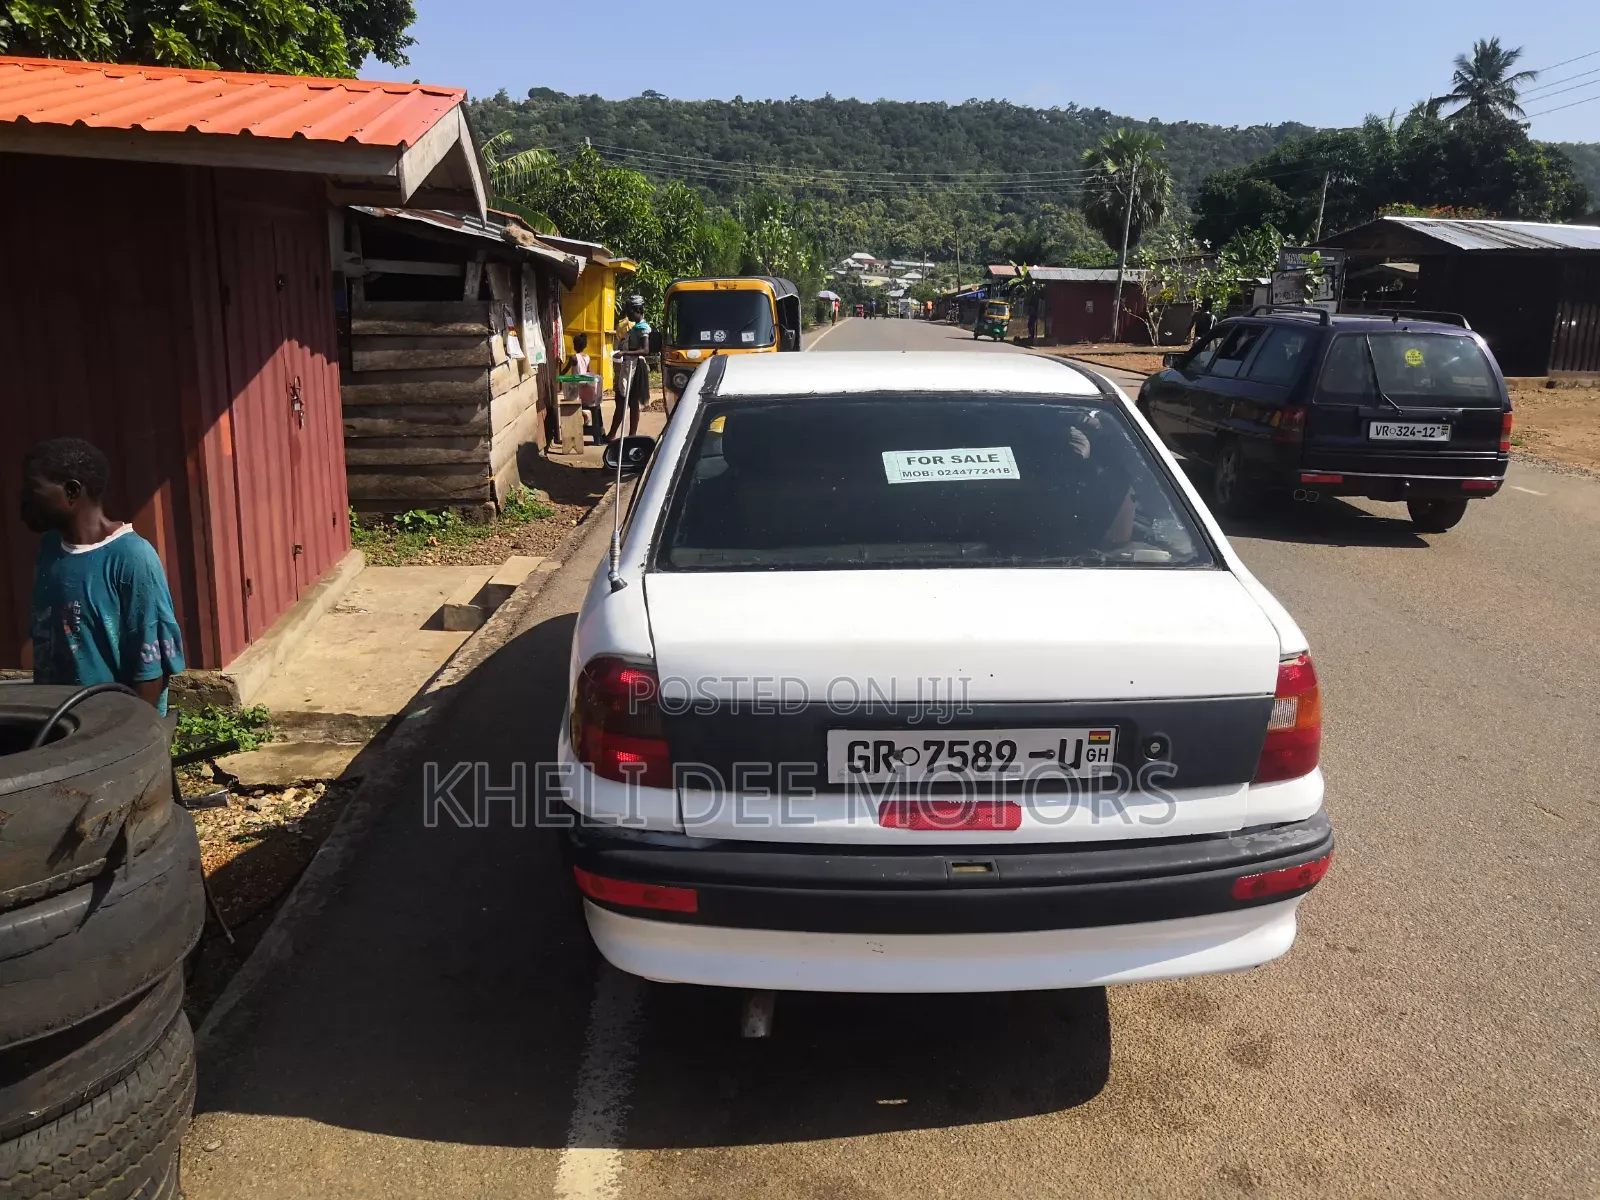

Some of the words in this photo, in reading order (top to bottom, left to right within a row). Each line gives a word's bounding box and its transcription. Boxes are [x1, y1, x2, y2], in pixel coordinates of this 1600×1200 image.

[1375, 425, 1390, 436] VR
[906, 455, 945, 466] FOR
[951, 453, 1000, 464] SALE
[902, 470, 934, 478] MOB:
[937, 467, 1010, 477] 0244772418
[847, 740, 897, 774] GR
[923, 739, 1018, 774] 7589
[1085, 747, 1109, 763] GH
